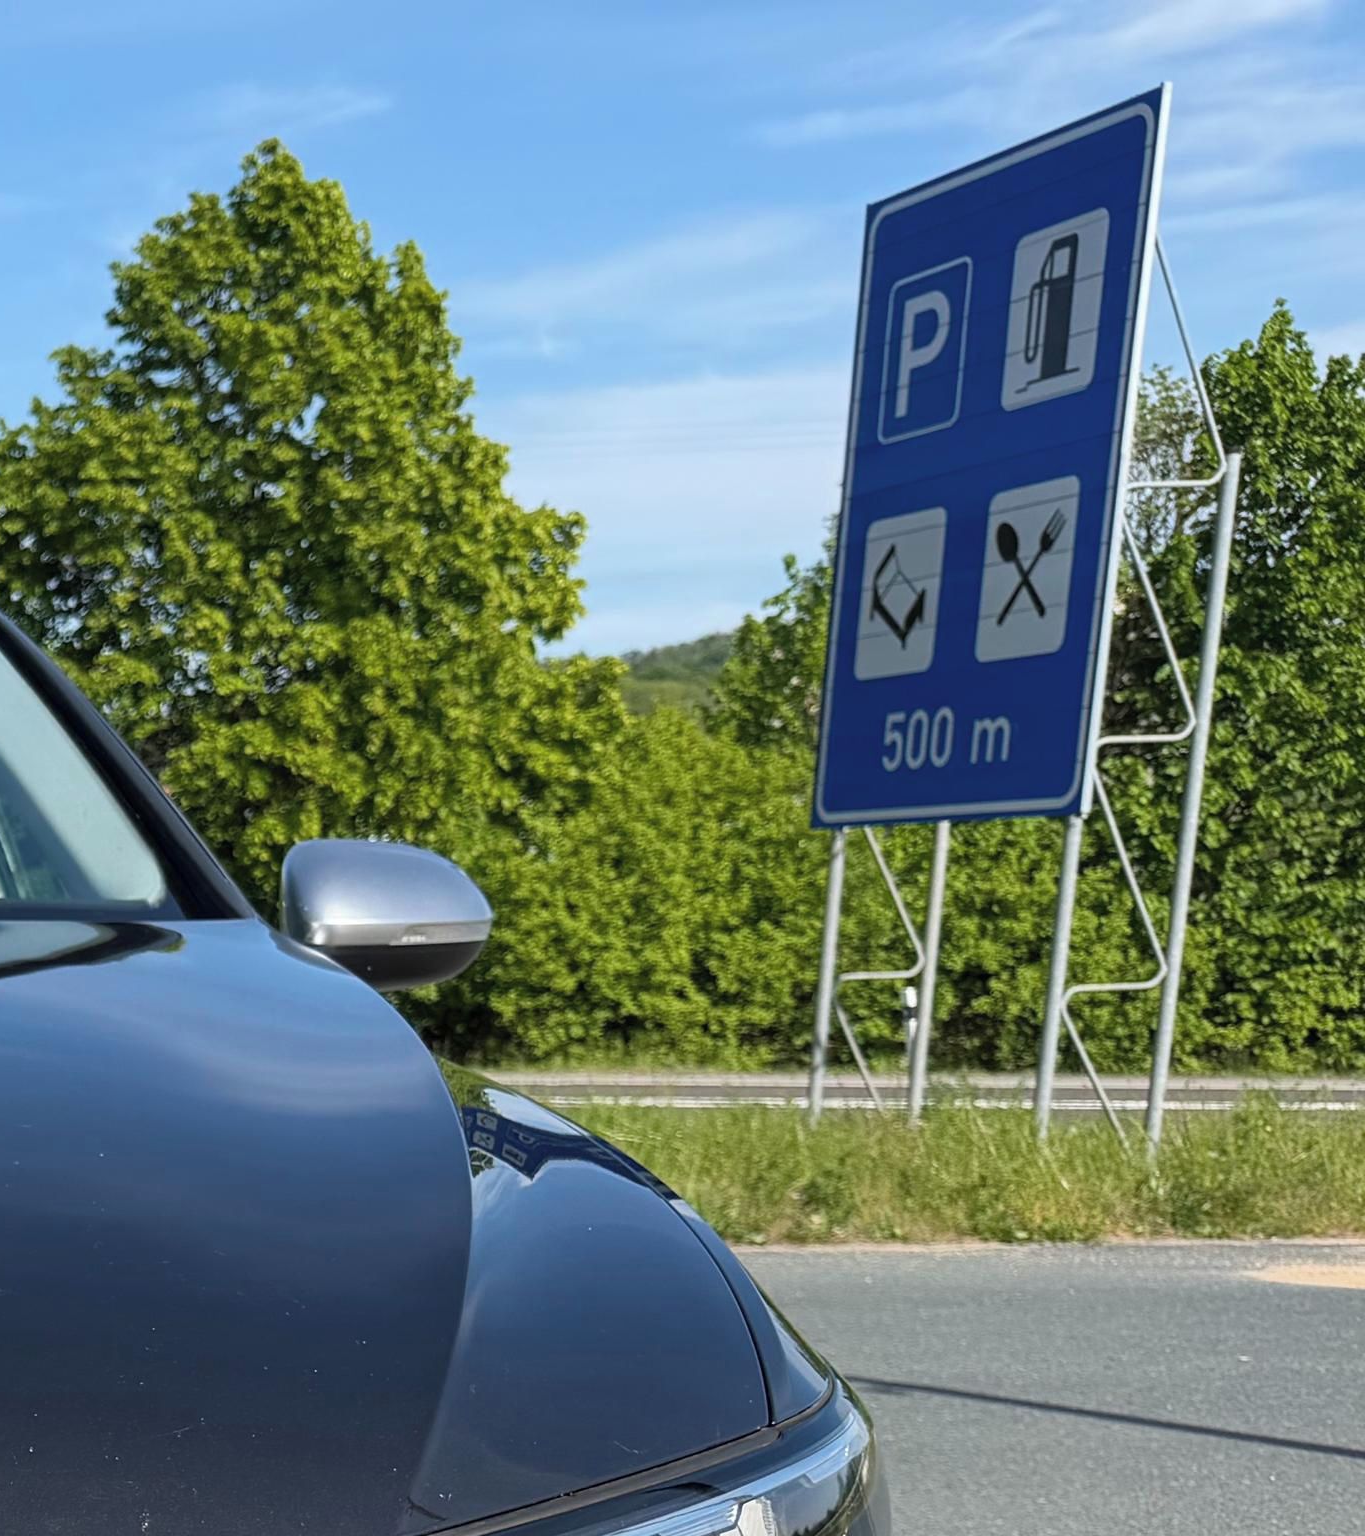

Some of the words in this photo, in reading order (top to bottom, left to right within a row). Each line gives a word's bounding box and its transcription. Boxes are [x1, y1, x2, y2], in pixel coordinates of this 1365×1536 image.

[895, 289, 951, 419] P
[881, 706, 955, 772] 500
[970, 715, 1011, 765] m
